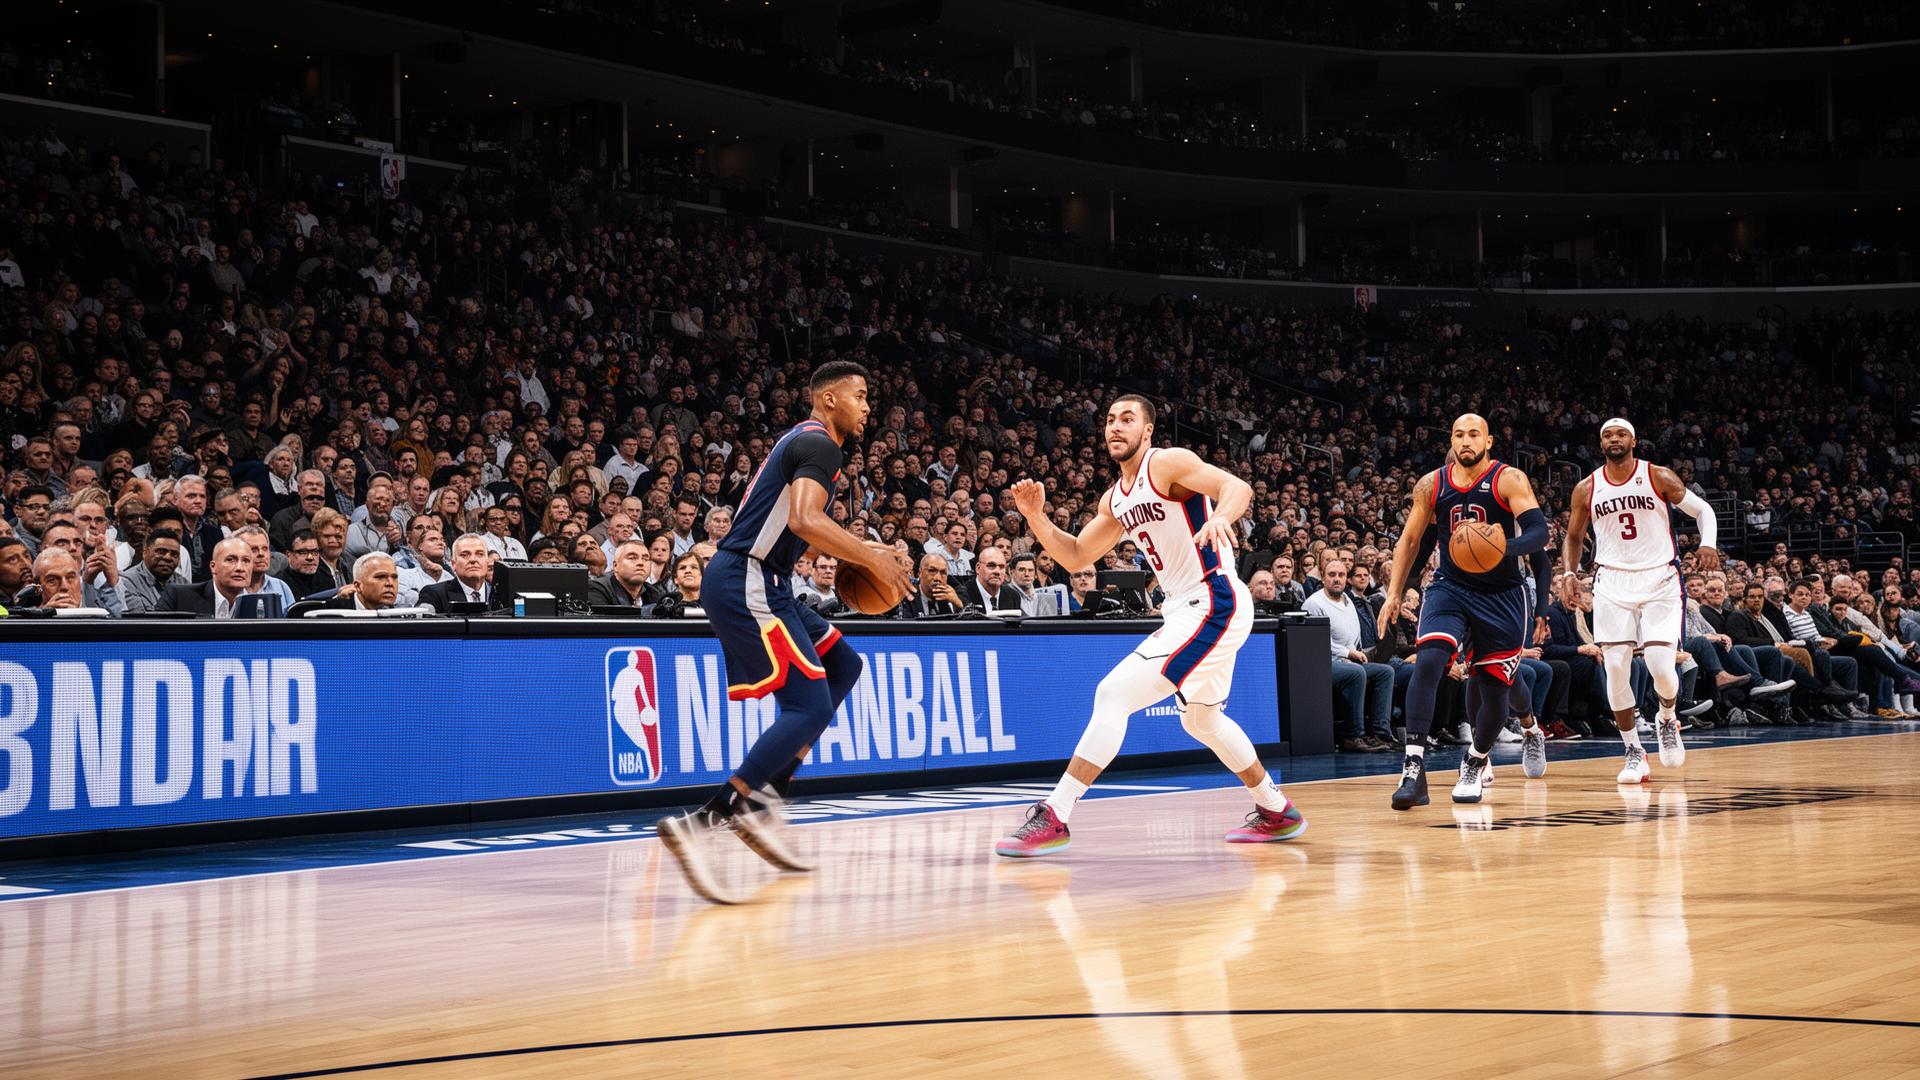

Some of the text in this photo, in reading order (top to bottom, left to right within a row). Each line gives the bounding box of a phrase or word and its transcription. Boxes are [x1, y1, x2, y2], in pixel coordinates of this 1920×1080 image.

[1618, 512, 1638, 541] 3
[1138, 530, 1164, 572] 3
[618, 751, 644, 774] NBA
